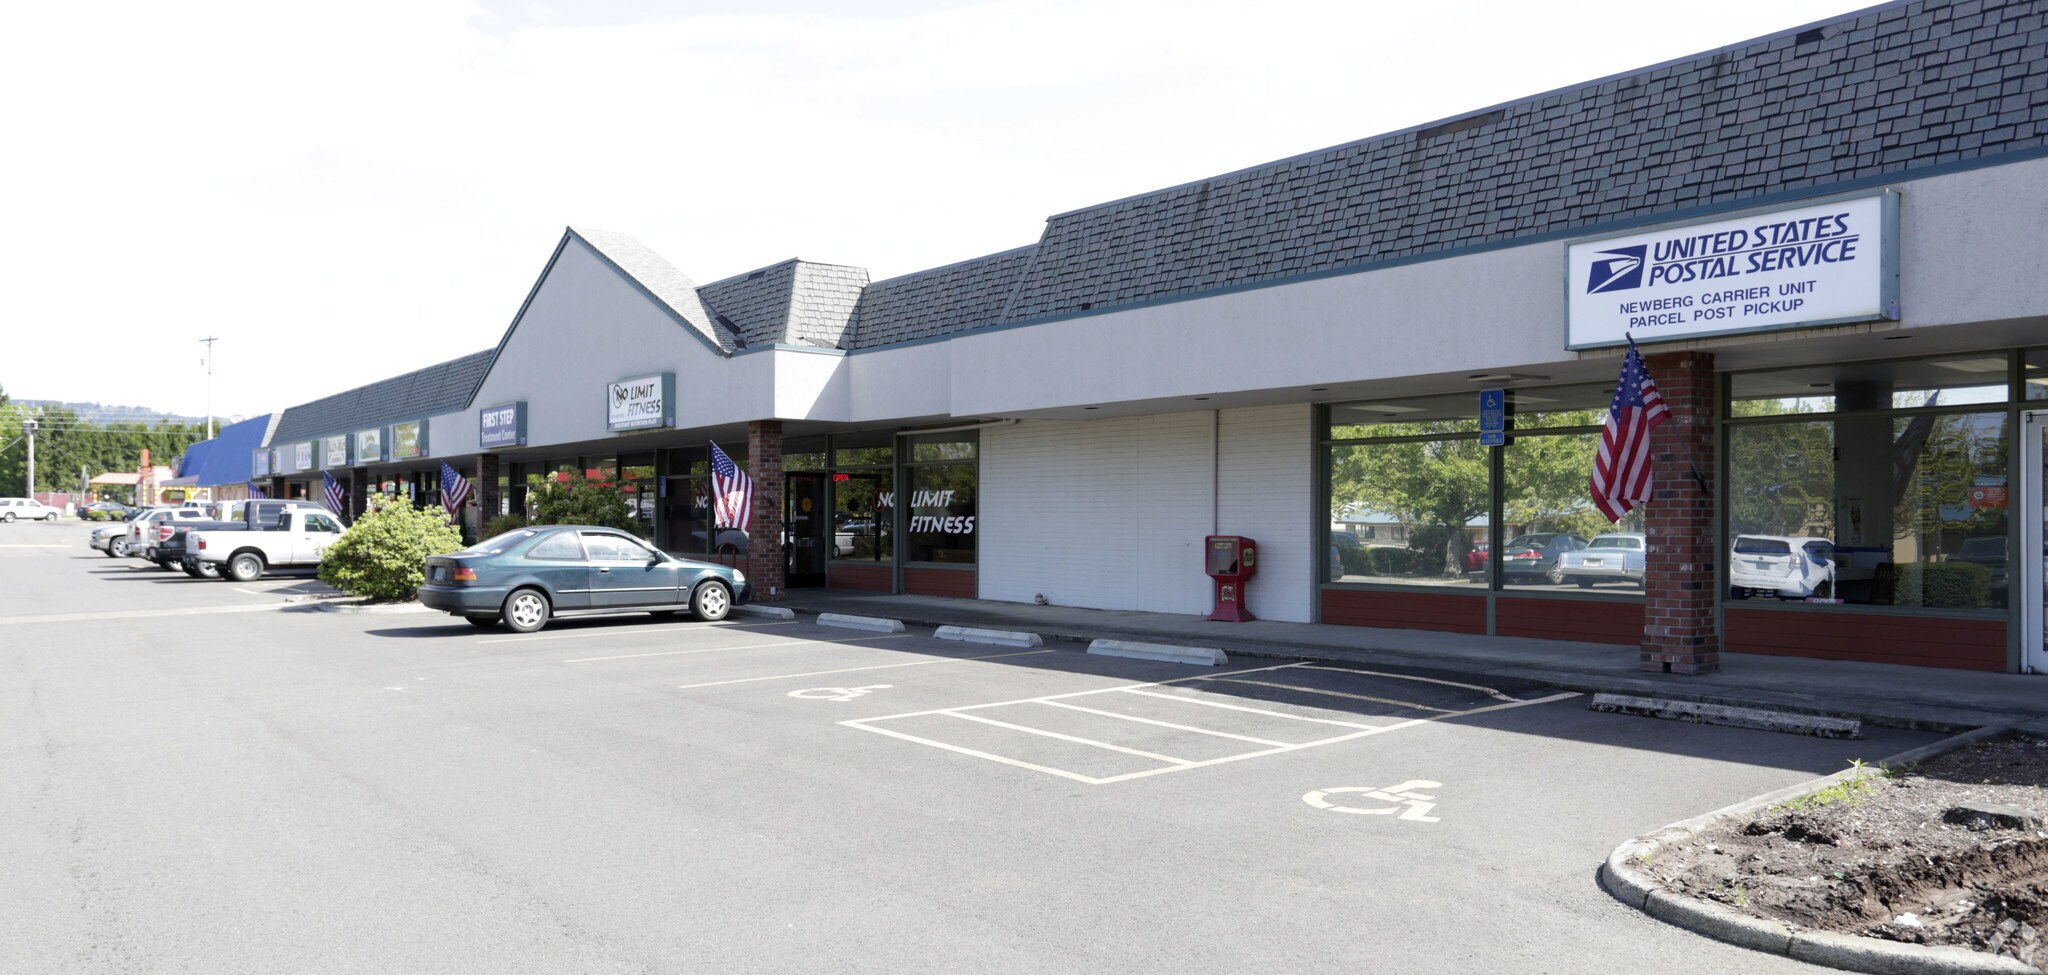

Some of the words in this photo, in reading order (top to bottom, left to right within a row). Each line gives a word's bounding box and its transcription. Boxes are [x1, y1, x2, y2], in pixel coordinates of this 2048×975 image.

[1653, 229, 1748, 262] UNITED
[1751, 213, 1850, 247] STATES
[1648, 256, 1741, 287] POSTAL
[1746, 237, 1860, 274] SERVICE
[1620, 295, 1694, 315] NEWBERG
[1701, 286, 1771, 305] CARRIER
[1779, 280, 1817, 297] UNIT
[1629, 311, 1686, 328] PARCEL
[1694, 306, 1736, 322] POST
[1744, 298, 1804, 316] PICKUP
[616, 387, 629, 401] NO
[631, 384, 654, 400] LIMIT
[627, 399, 661, 417] FITNESS
[483, 411, 499, 428] FIRST
[499, 408, 514, 426] STEP
[833, 474, 849, 482] OPEN
[910, 489, 955, 508] LIMIT
[909, 515, 976, 534] FITNESS
